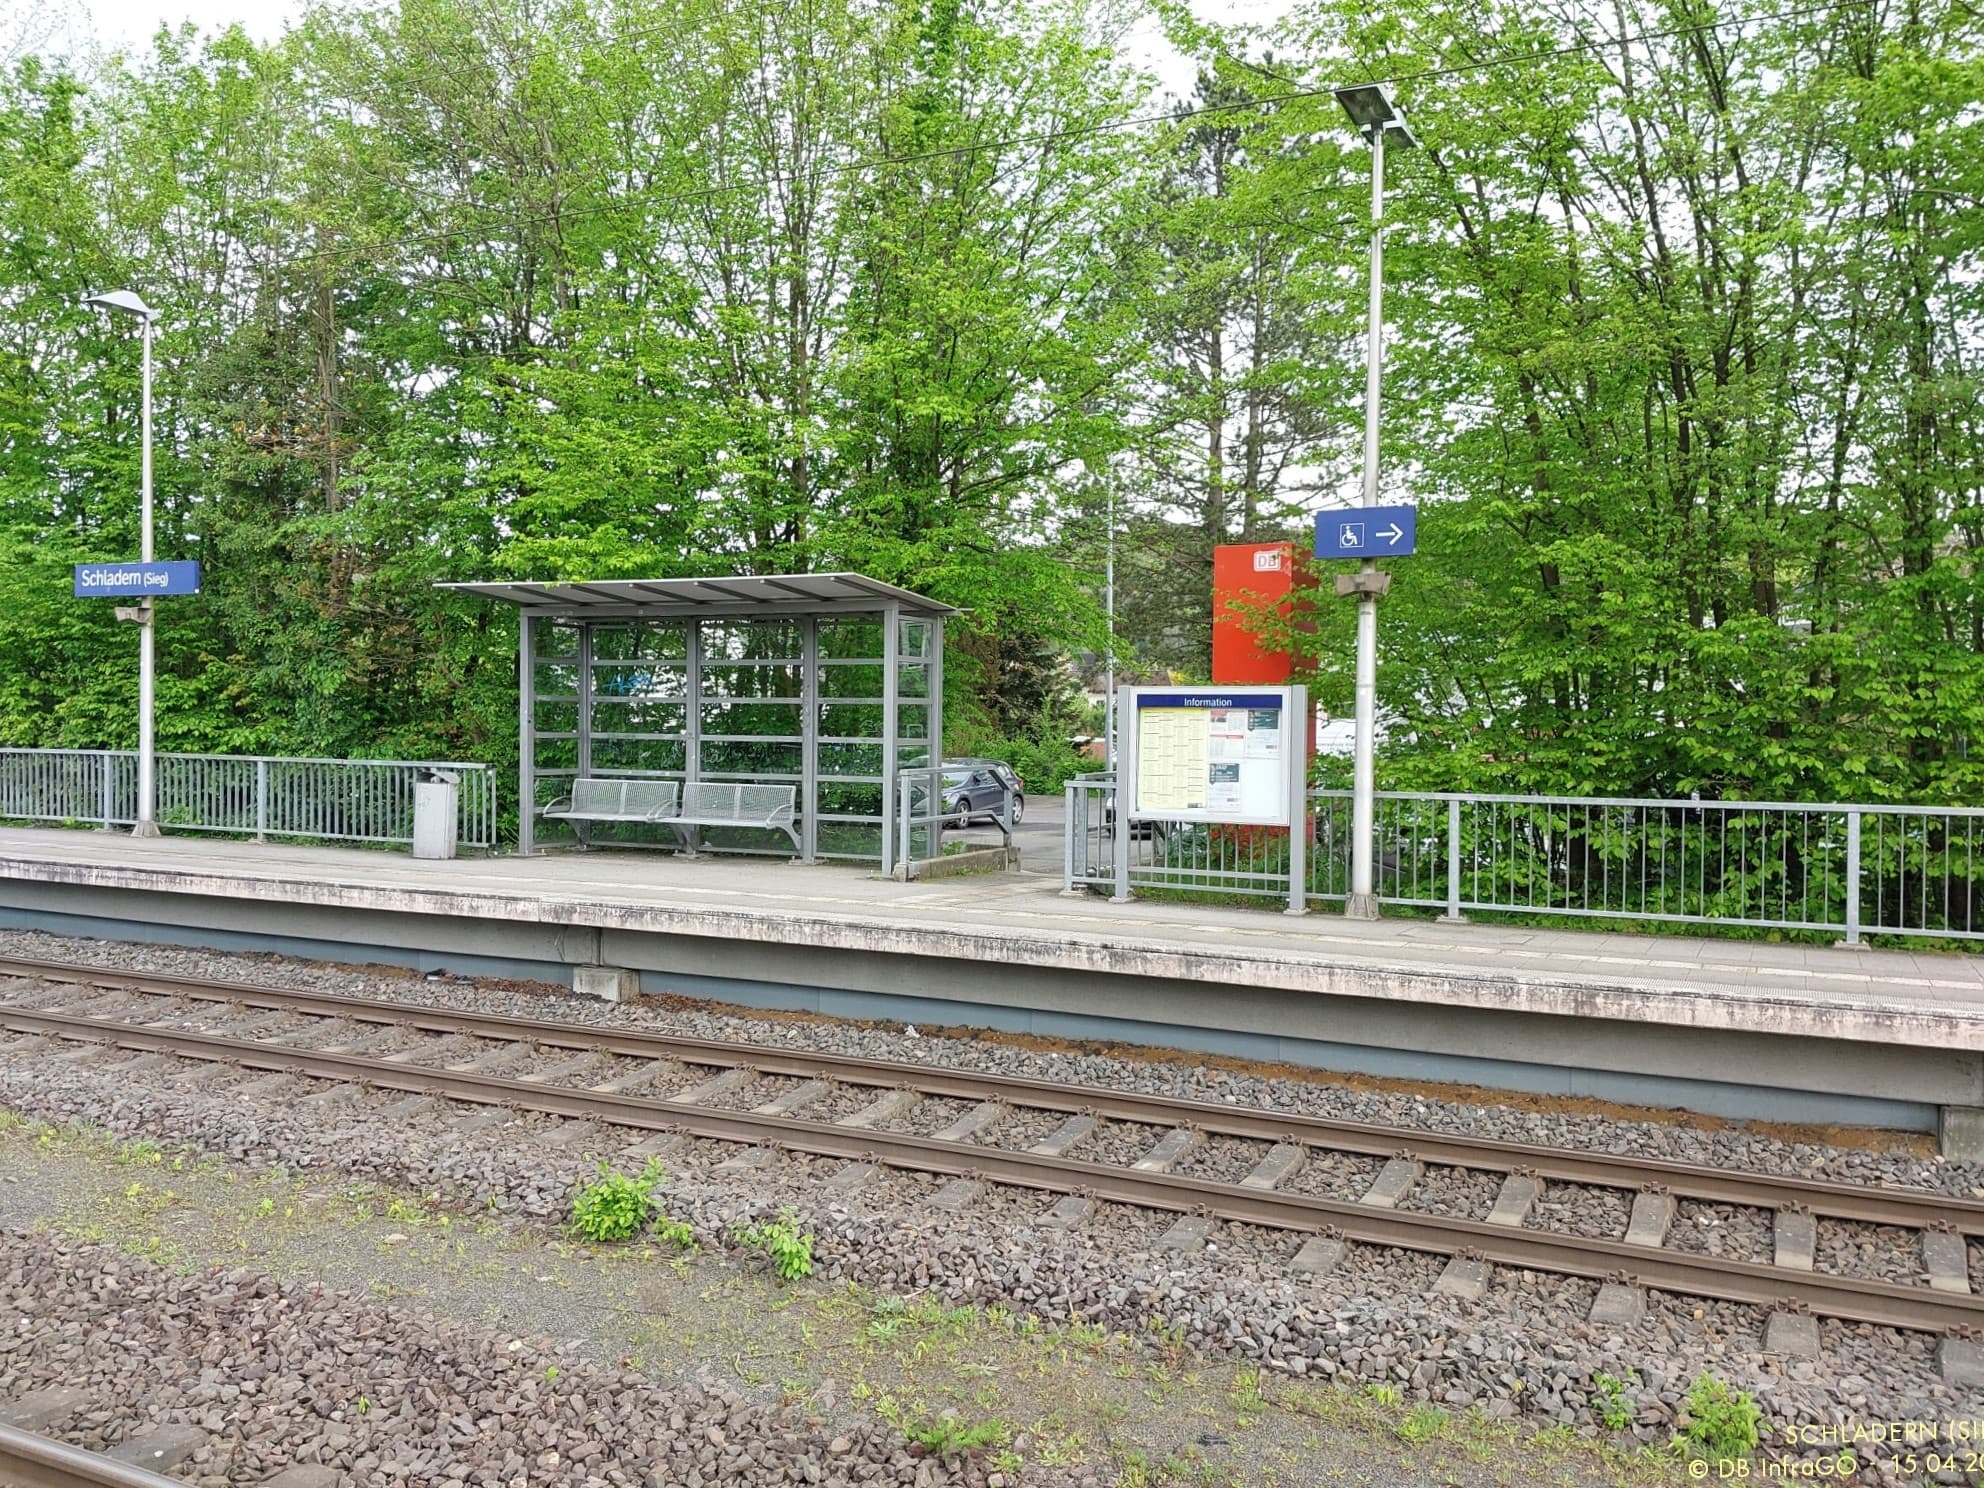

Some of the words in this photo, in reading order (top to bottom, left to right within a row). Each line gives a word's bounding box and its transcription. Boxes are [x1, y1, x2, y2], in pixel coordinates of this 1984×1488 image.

[1258, 555, 1277, 567] DB
[81, 569, 141, 587] Schladern
[143, 572, 169, 588] (Sieg)
[1184, 697, 1232, 707] Information
